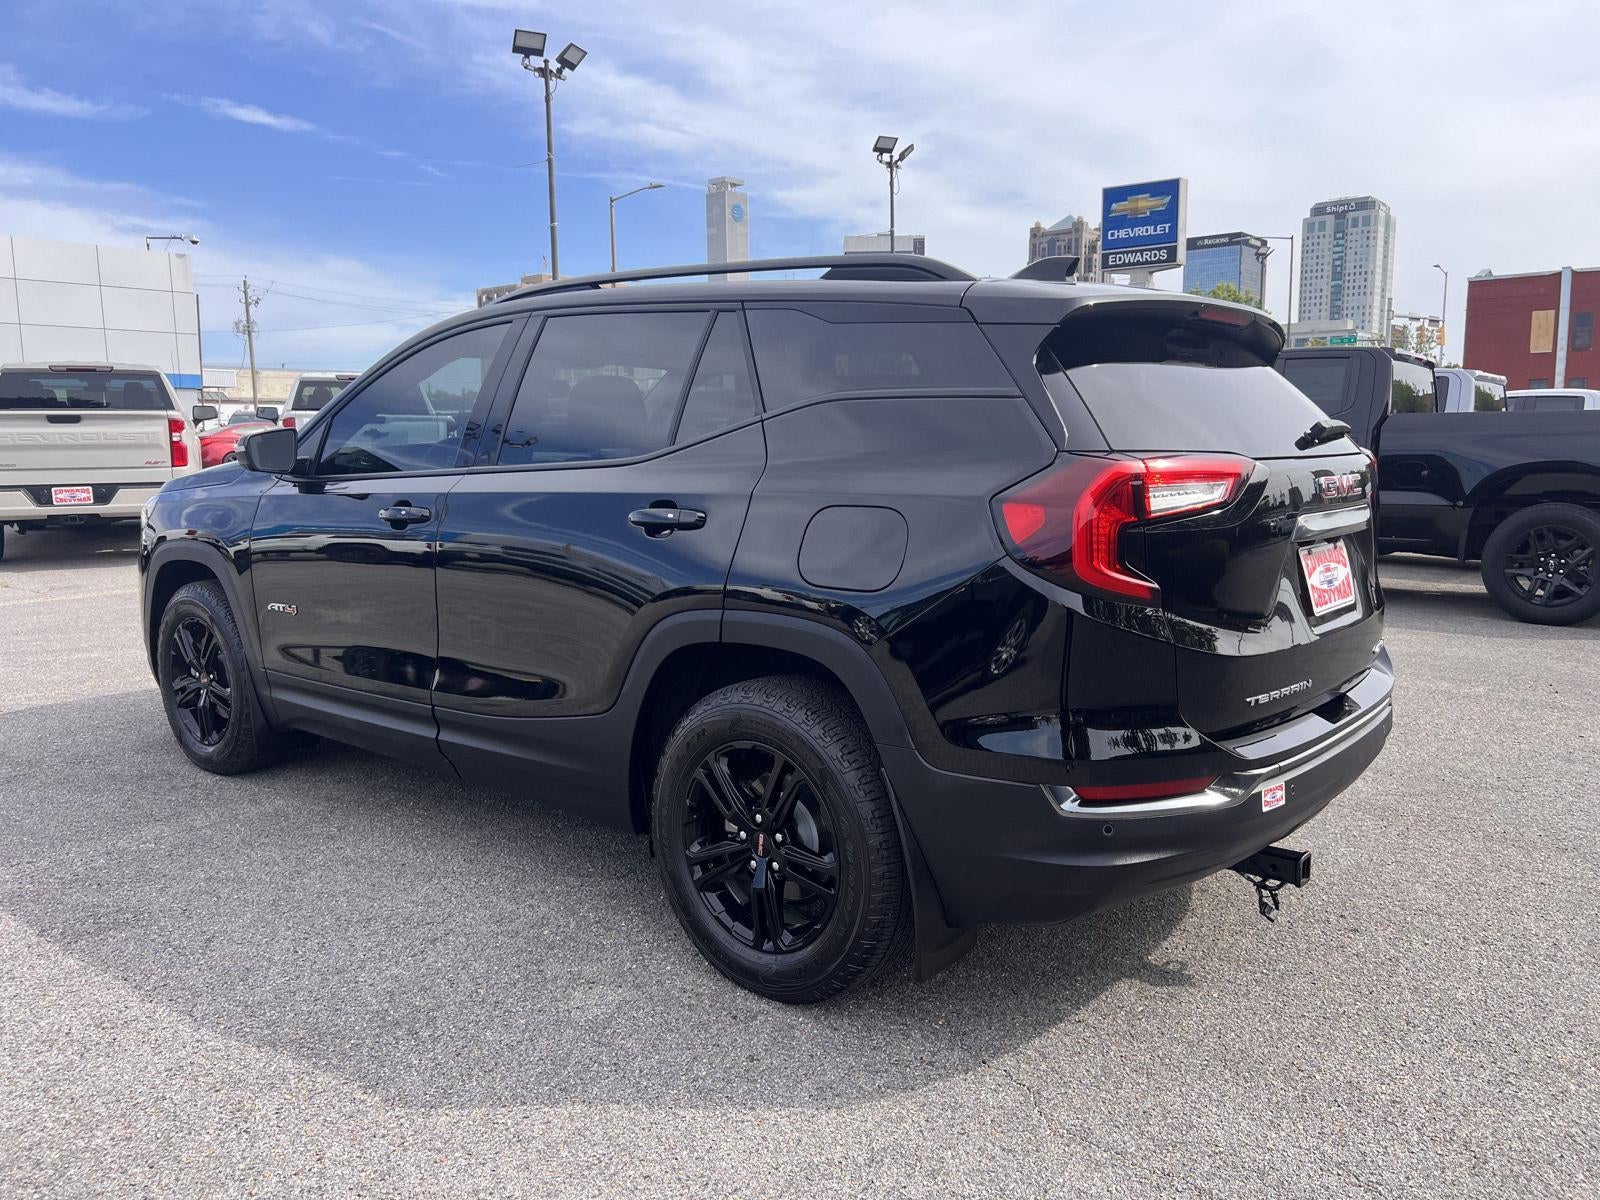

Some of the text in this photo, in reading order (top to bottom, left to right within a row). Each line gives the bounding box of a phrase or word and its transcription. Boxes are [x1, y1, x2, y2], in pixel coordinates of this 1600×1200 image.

[1107, 223, 1171, 240] CHEVROLET
[1108, 249, 1167, 265] EDWARDS
[53, 488, 91, 496] EDWARDS
[1321, 473, 1362, 498] GMC
[1303, 547, 1347, 578] EDWARDS
[1310, 572, 1353, 609] CHEVYMAN
[1245, 679, 1313, 706] TERRAIN
